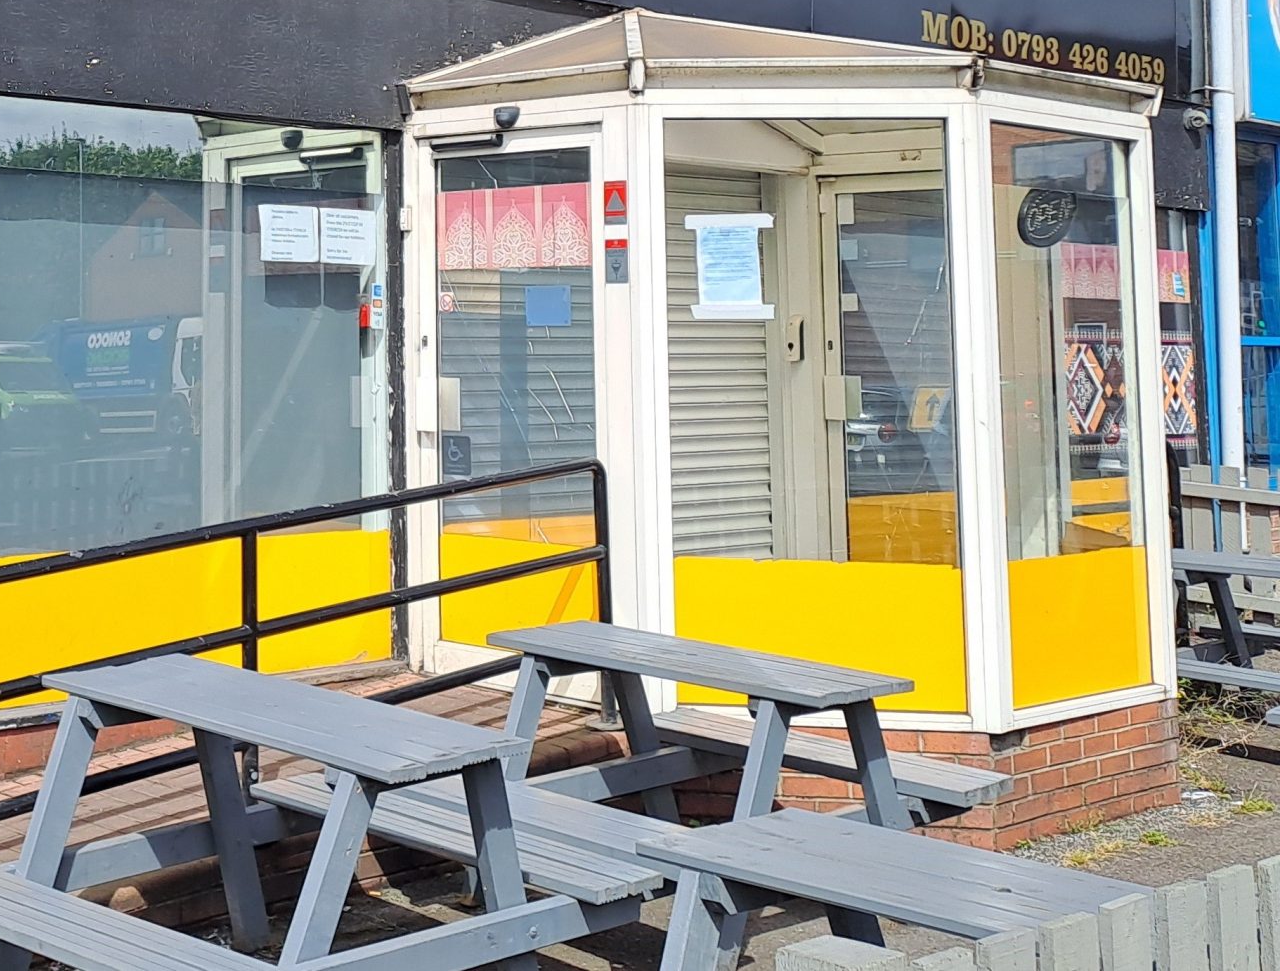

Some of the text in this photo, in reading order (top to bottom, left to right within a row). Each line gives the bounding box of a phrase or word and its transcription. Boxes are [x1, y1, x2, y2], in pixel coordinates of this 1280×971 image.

[921, 10, 1165, 84] MOB: 0793 426 4059
